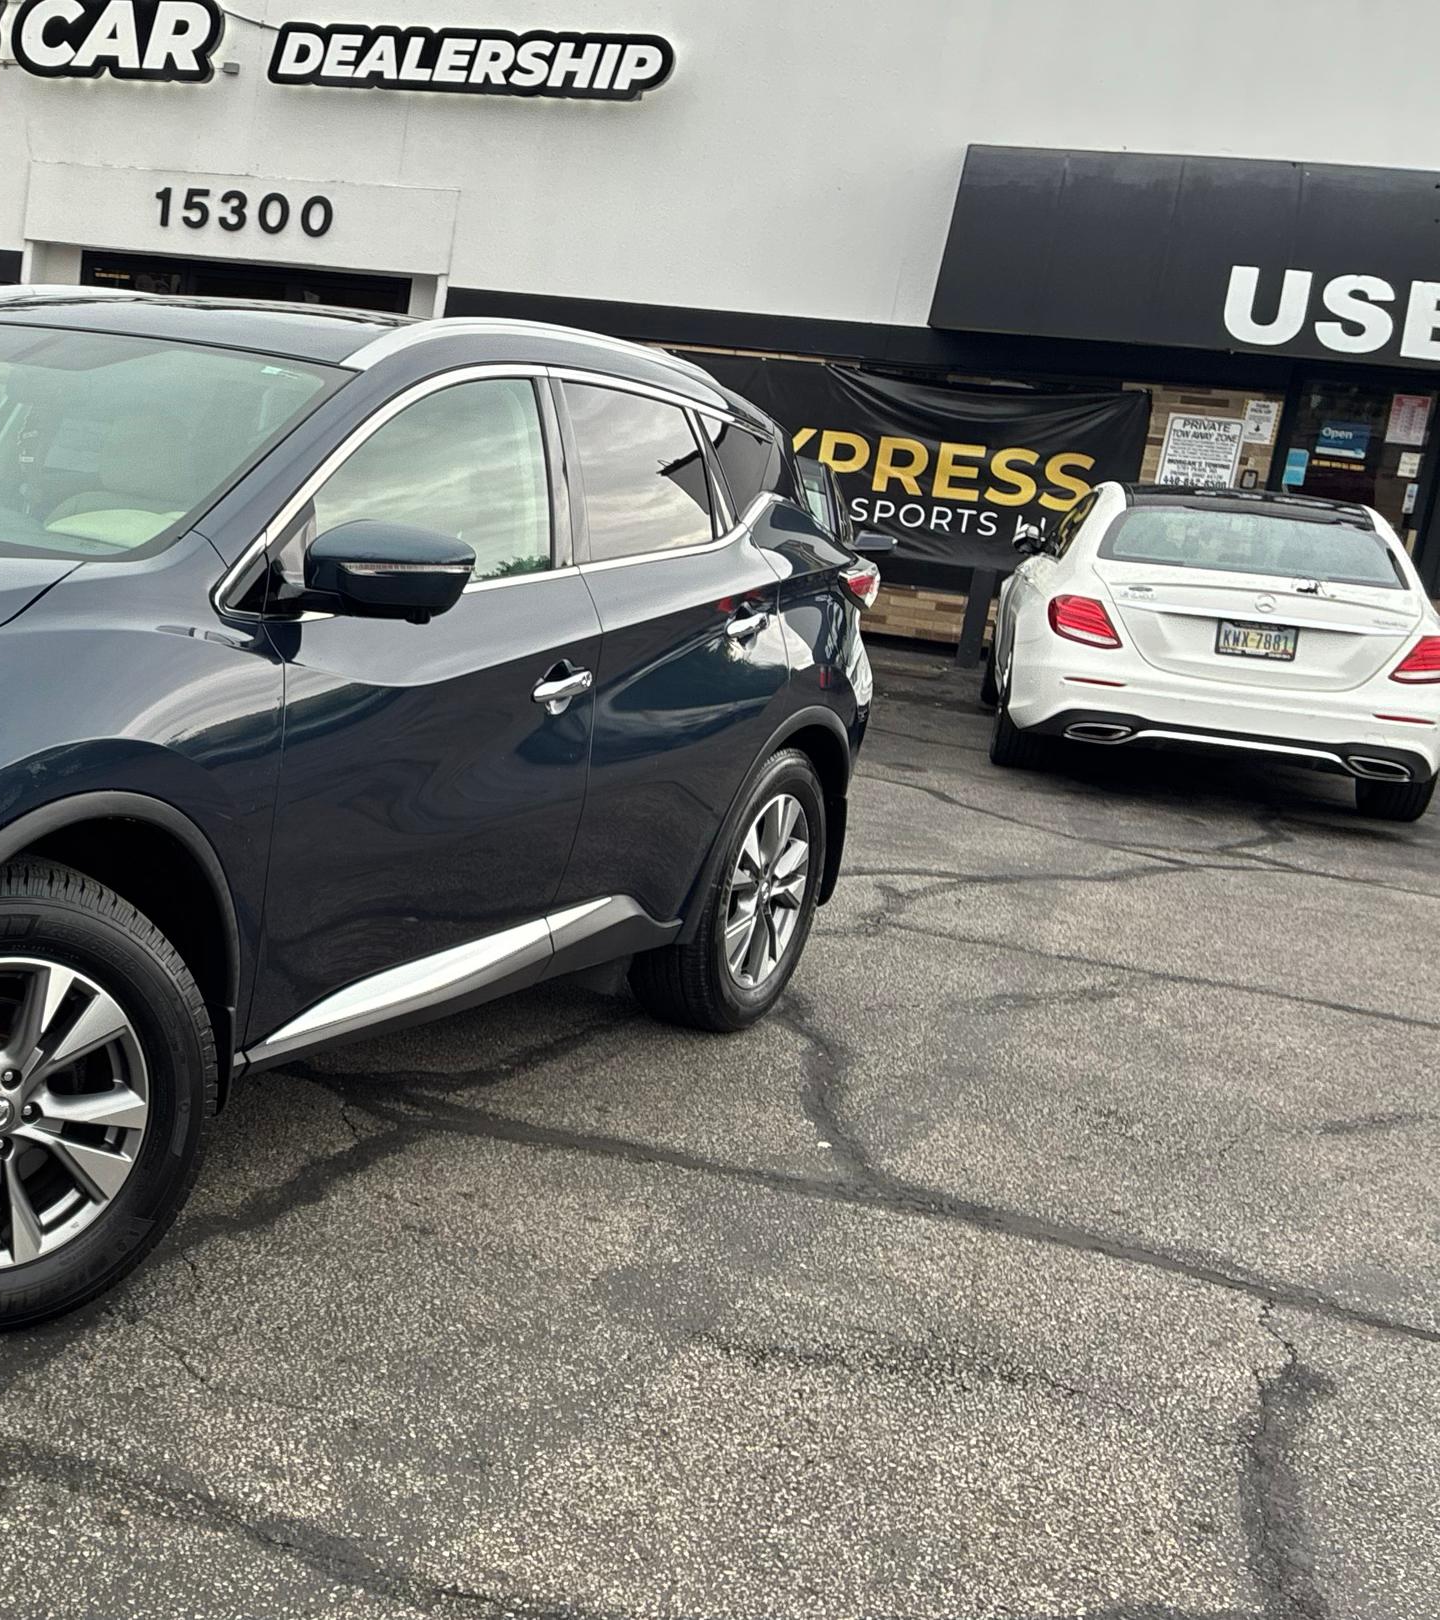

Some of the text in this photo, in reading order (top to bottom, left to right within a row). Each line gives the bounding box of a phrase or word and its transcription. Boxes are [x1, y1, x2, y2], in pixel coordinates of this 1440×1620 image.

[20, 0, 211, 72] CAR
[277, 31, 662, 92] DEALERSHIP
[156, 186, 333, 238] 15300
[1182, 419, 1231, 433] PRIVATE
[1322, 427, 1353, 440] Open
[792, 428, 1096, 512] PRESS
[849, 497, 999, 537] SPORTS
